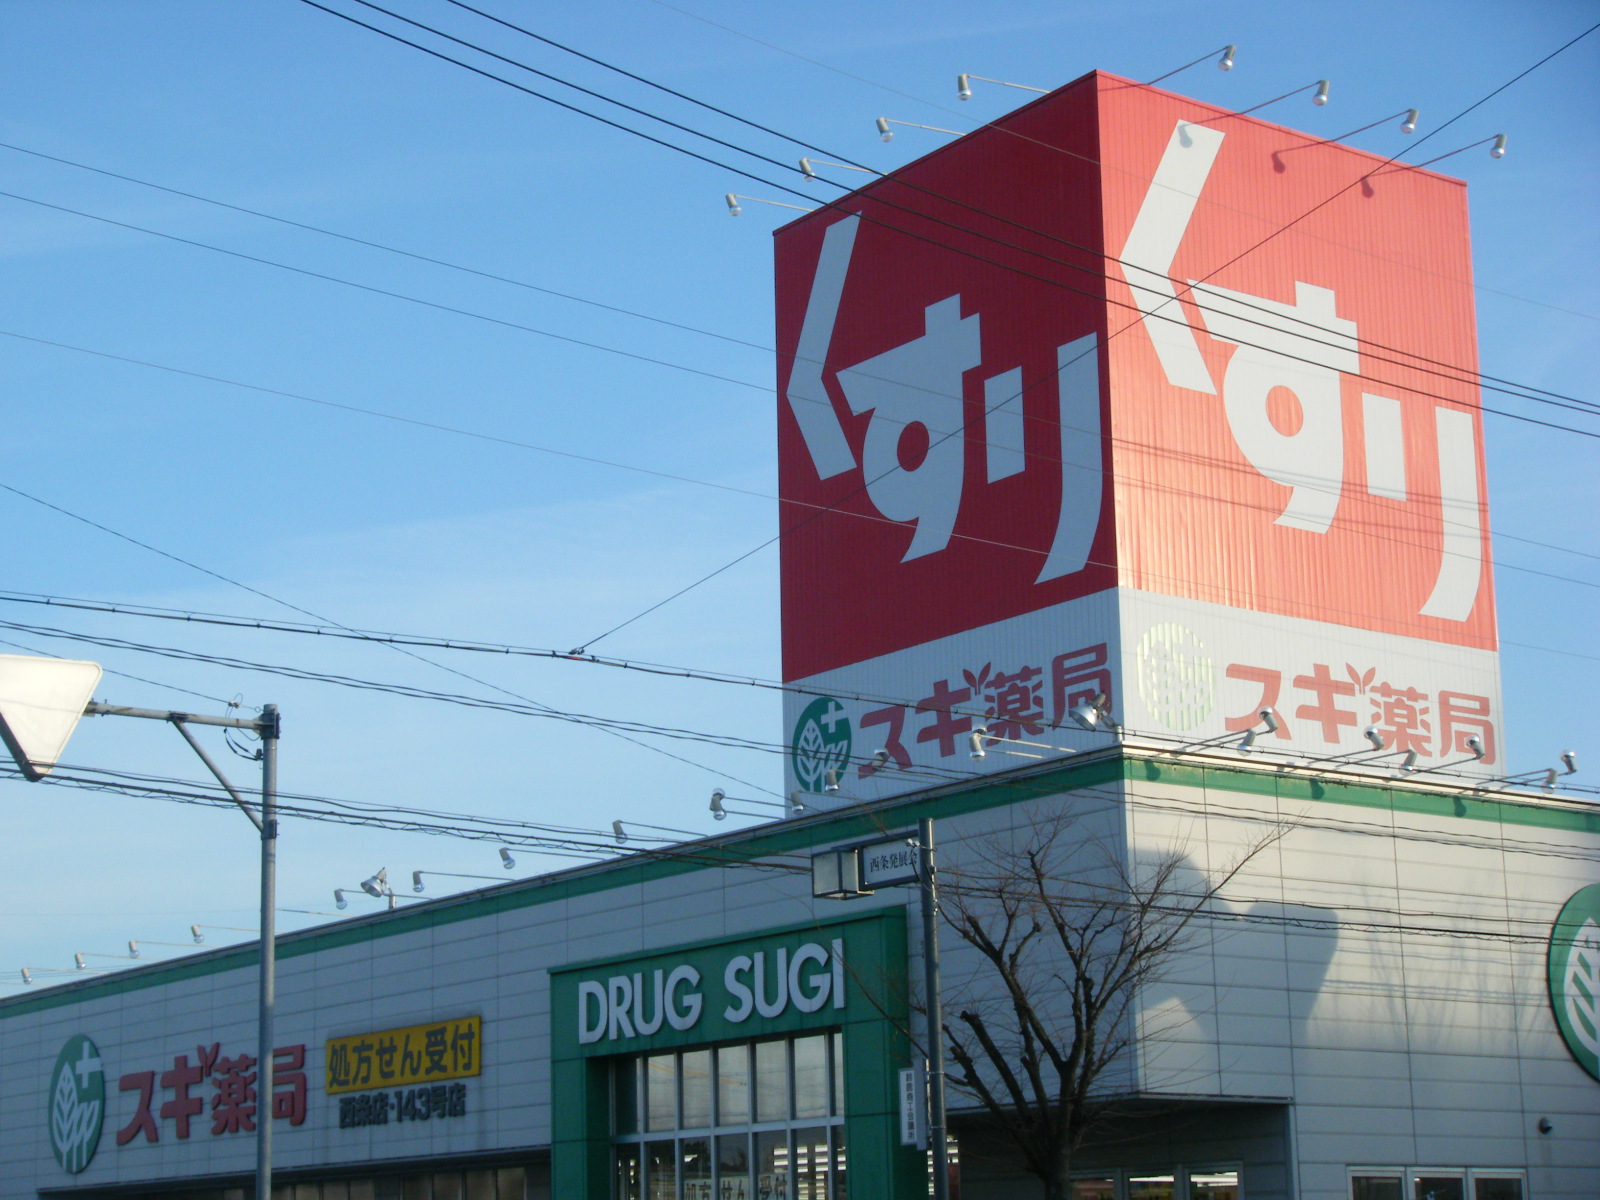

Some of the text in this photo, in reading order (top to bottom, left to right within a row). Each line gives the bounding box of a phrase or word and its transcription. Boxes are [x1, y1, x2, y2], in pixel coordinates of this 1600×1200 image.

[786, 211, 1102, 585] くすり
[1119, 119, 1483, 623] くすり
[869, 848, 918, 873] 西条発展会
[578, 938, 846, 1045] DRUG SUGI
[328, 1023, 475, 1087] 処方せん受付
